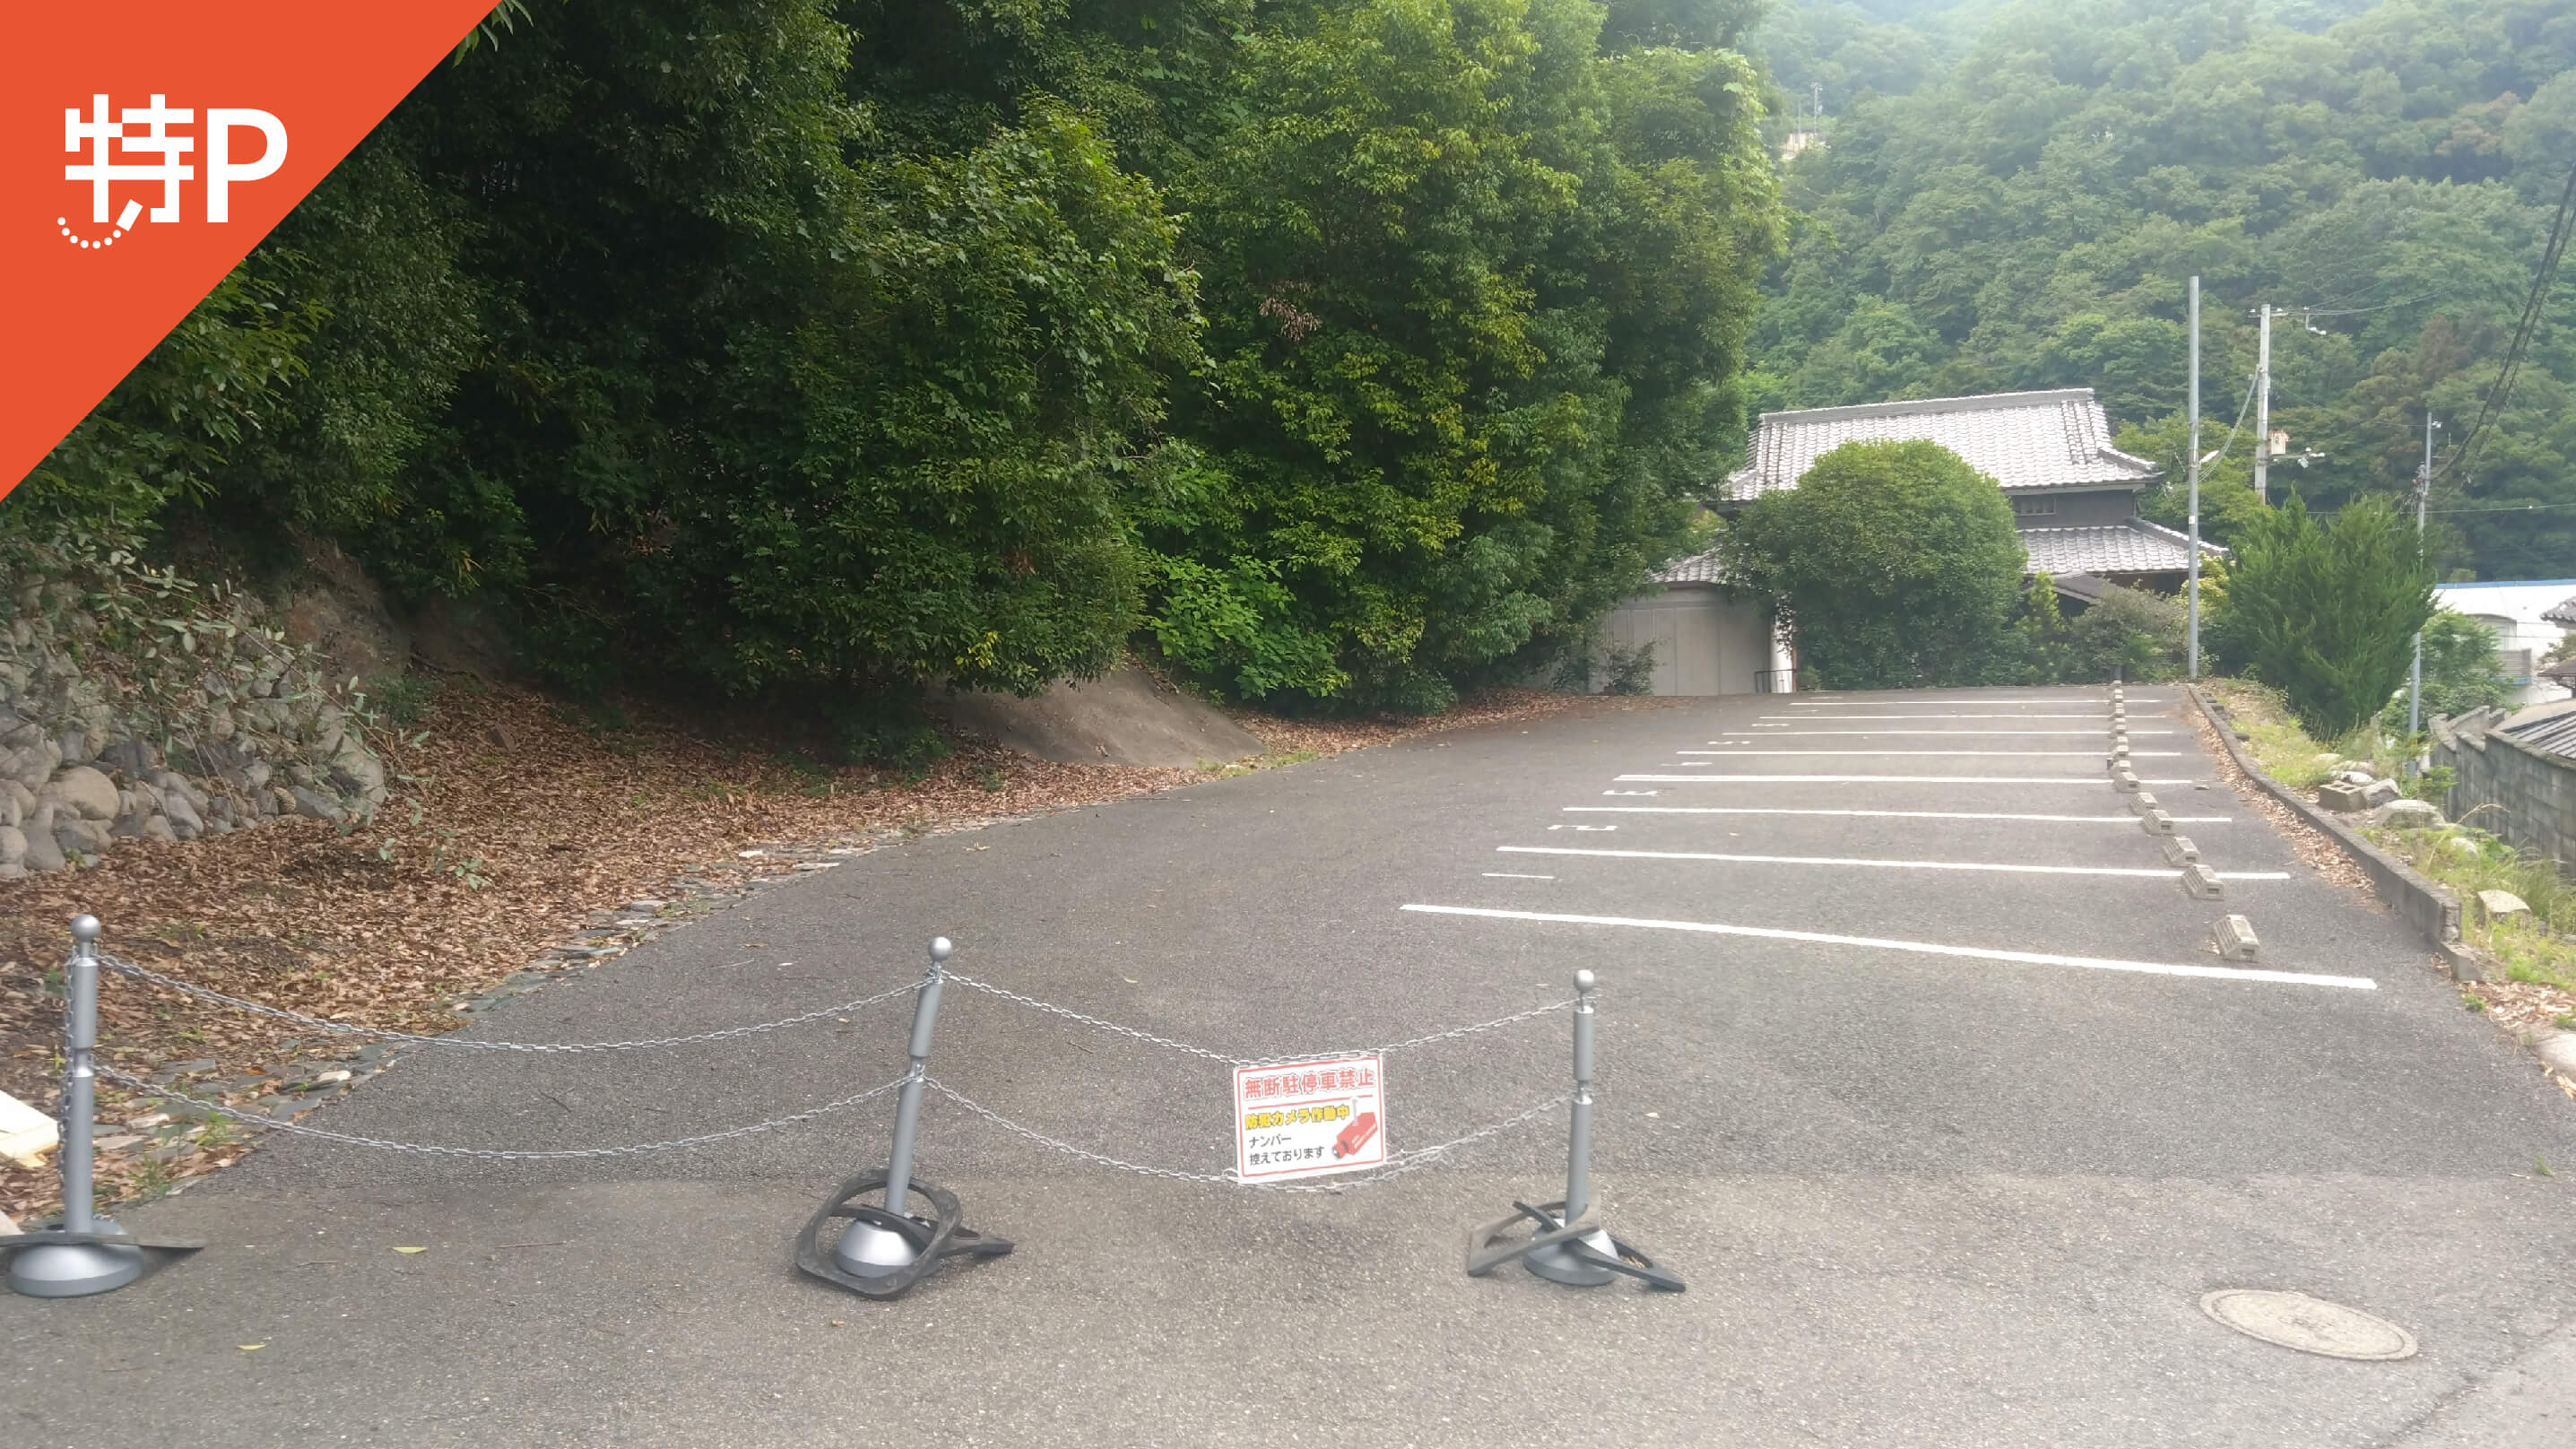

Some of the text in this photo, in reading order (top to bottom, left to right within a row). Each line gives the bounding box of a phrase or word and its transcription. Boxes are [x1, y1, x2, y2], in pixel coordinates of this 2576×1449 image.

[1244, 1067, 1375, 1099] 無断駐停車禁止
[1249, 1134, 1292, 1149] ナンバー
[1250, 1146, 1325, 1166] 控えております
